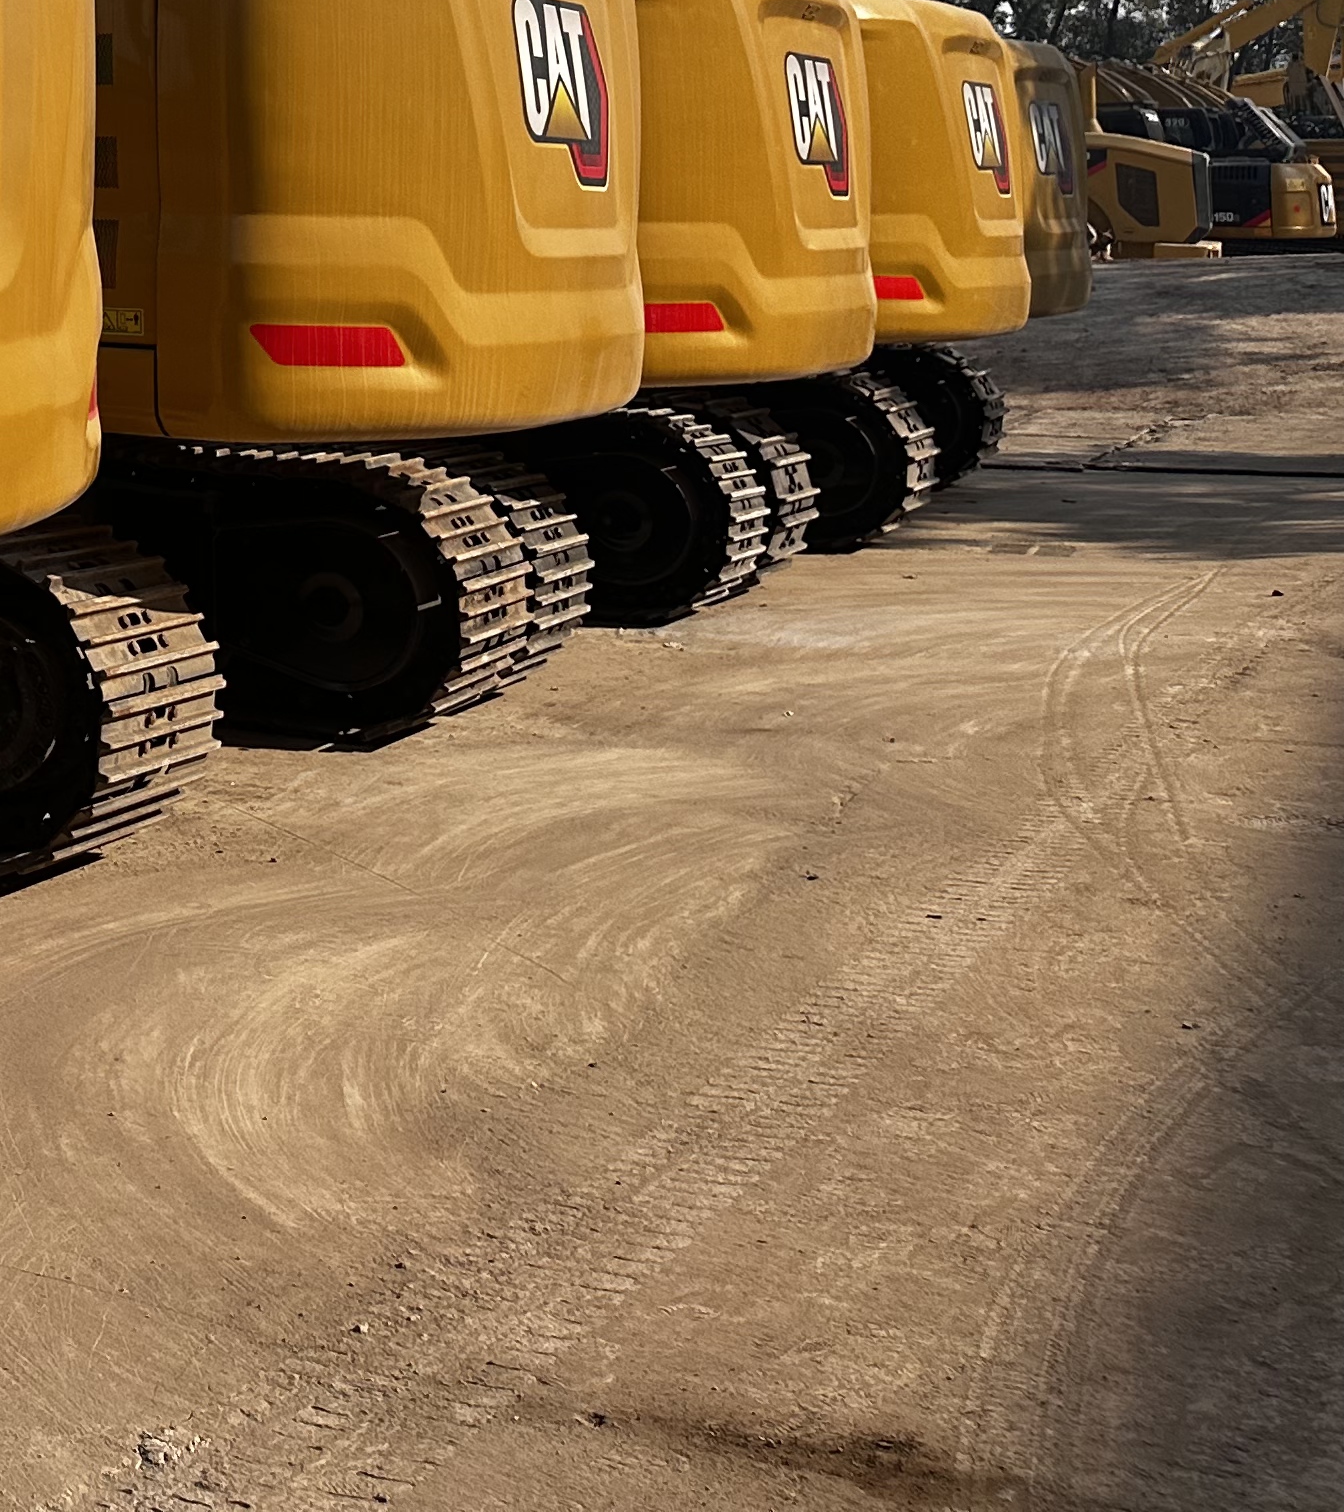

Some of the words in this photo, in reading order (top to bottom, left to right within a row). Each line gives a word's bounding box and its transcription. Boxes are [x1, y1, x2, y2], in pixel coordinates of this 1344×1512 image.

[786, 54, 838, 161] CAT
[963, 82, 1002, 167] CAT
[1029, 103, 1065, 173] CAT
[1320, 184, 1336, 223] CA
